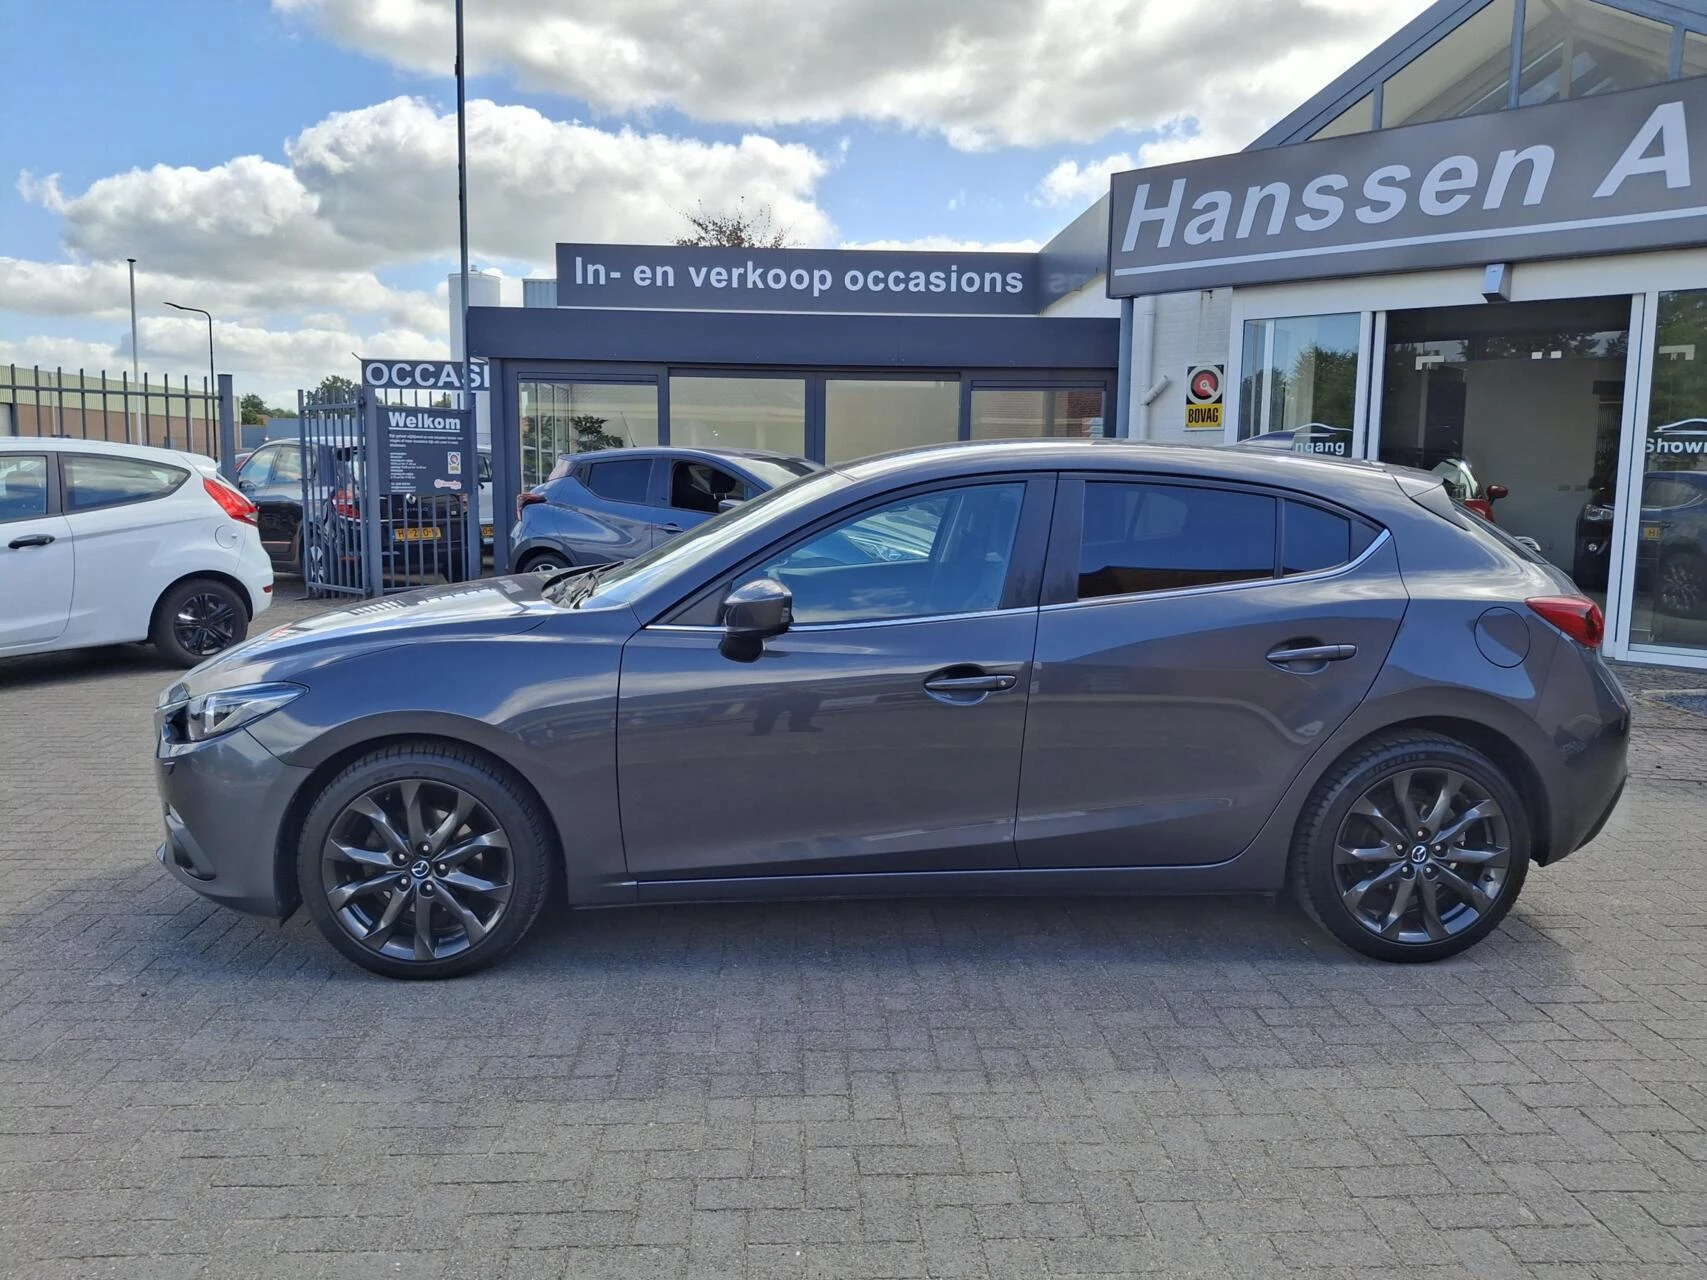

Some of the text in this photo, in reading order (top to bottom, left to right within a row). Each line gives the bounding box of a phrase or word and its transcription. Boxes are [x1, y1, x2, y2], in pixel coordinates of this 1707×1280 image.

[1121, 100, 1691, 252] Hanssen A
[575, 256, 621, 285] In-
[633, 264, 674, 287] en
[688, 260, 833, 297] verkoop
[844, 264, 1024, 293] occasions
[366, 362, 490, 388] OCCASI
[388, 411, 461, 430] Welkom
[1188, 407, 1219, 424] BOVAG
